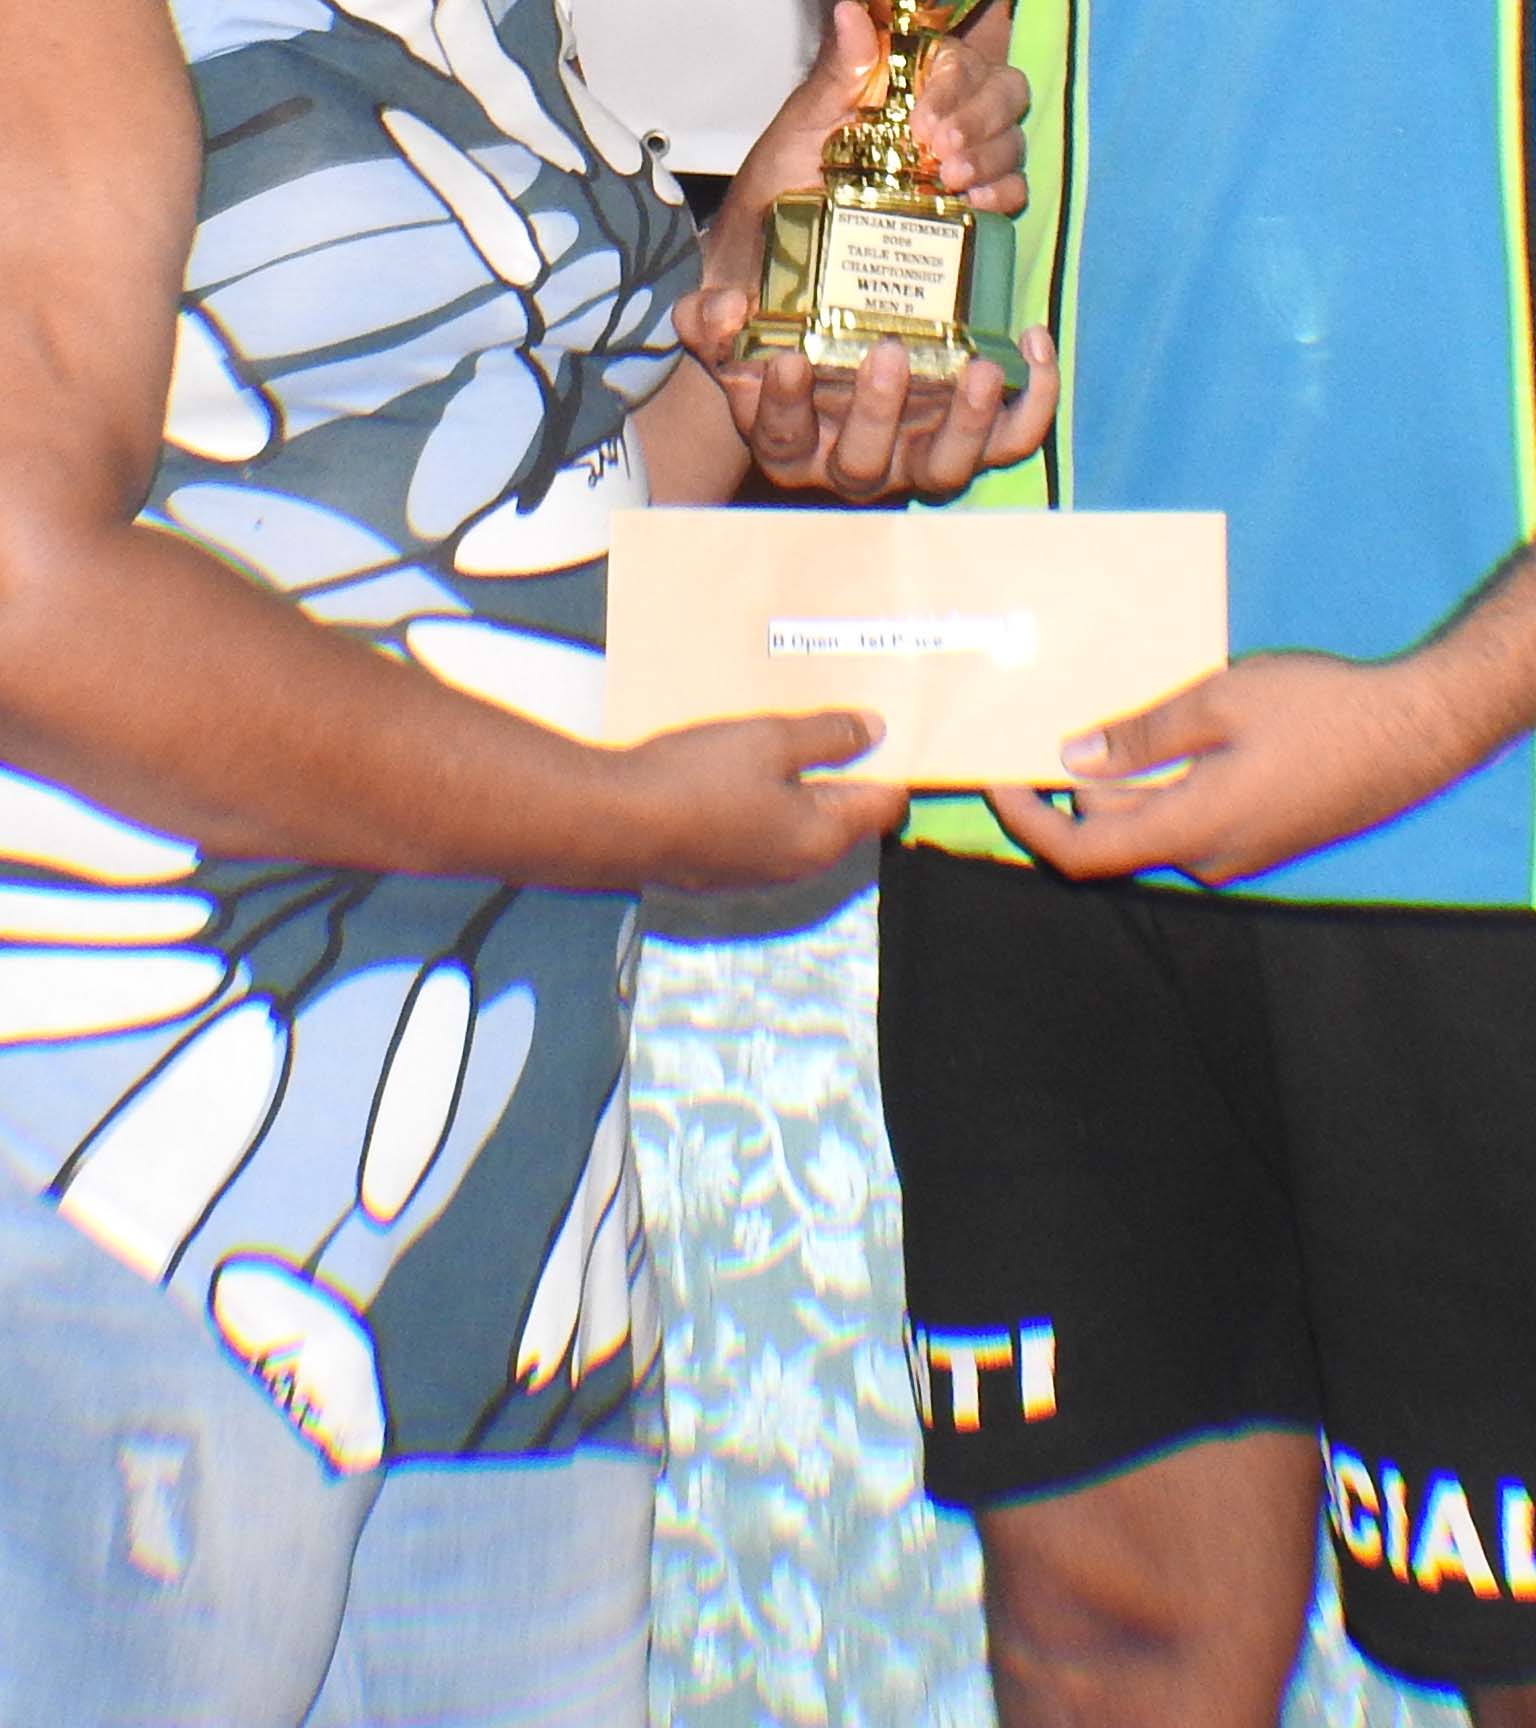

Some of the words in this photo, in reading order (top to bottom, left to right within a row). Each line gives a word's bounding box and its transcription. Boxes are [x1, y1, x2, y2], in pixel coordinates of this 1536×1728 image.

[838, 213, 896, 230] SPINJAM
[899, 221, 959, 239] SUMMER
[847, 245, 889, 260] TABLE
[893, 251, 944, 267] TENNIS
[841, 260, 944, 283] CHAMPIONSHIP
[857, 278, 925, 299] WINNER
[864, 298, 899, 312] MEN
